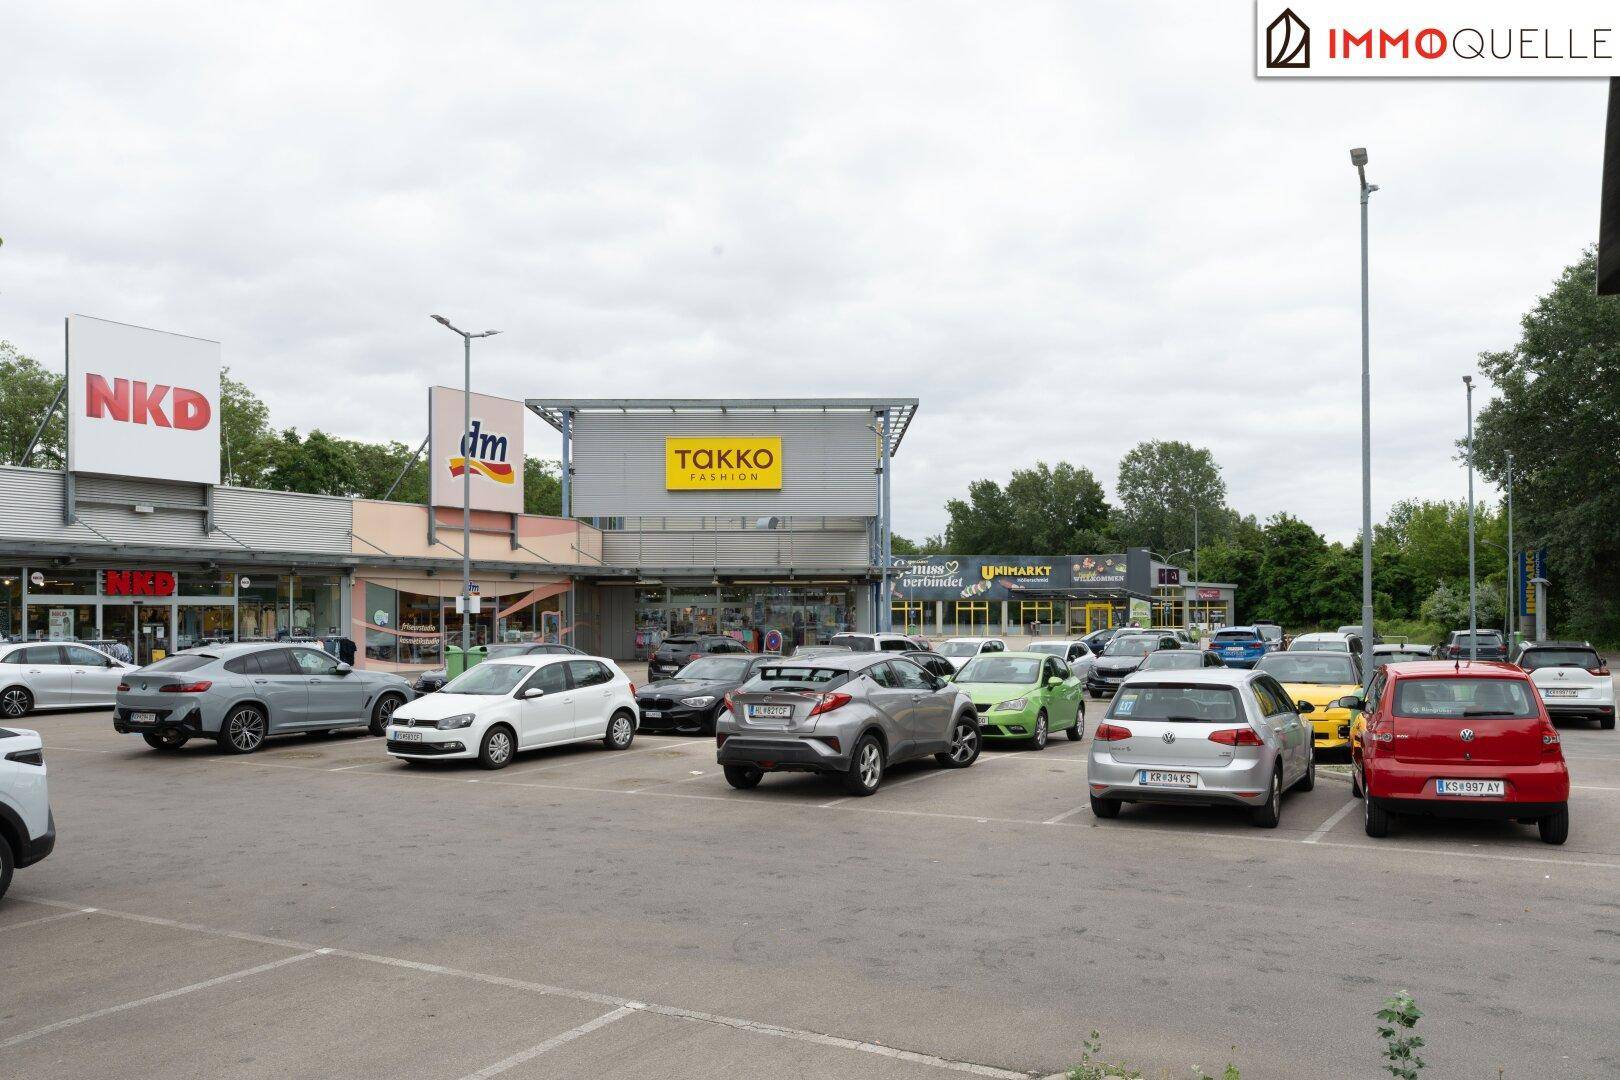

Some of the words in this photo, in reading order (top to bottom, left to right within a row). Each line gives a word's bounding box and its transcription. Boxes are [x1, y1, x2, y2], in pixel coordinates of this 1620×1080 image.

[86, 372, 211, 431] NKD
[460, 420, 508, 462] dm
[690, 473, 759, 482] FASHION
[981, 565, 1052, 580] UNIMARKT
[106, 570, 176, 596] NKD
[902, 575, 963, 588] verbindet
[1150, 772, 1161, 782] KR
[1168, 773, 1178, 783] 34
[1180, 774, 1192, 784] KS
[1445, 781, 1459, 792] KS
[1465, 782, 1485, 792] 997
[1486, 782, 1500, 793] AY
